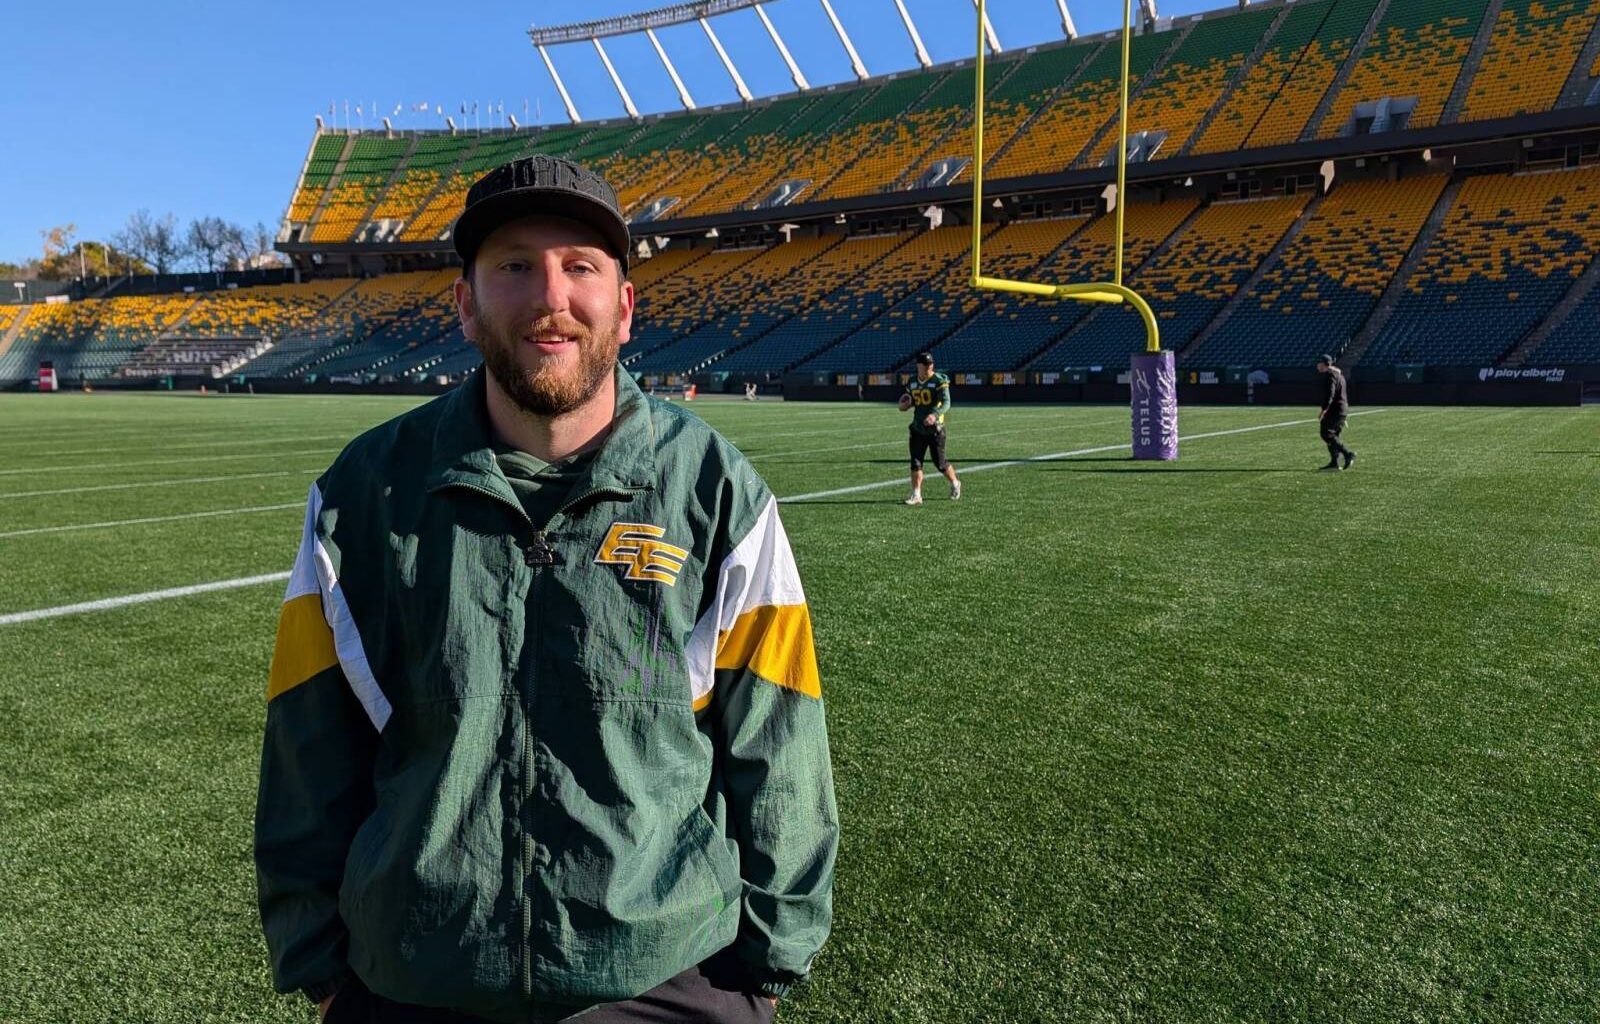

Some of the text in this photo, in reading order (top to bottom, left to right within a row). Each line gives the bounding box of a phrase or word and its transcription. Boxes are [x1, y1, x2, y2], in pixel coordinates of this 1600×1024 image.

[1494, 368, 1565, 378] play alberta
[911, 388, 932, 406] 50
[1140, 398, 1150, 446] TELUS
